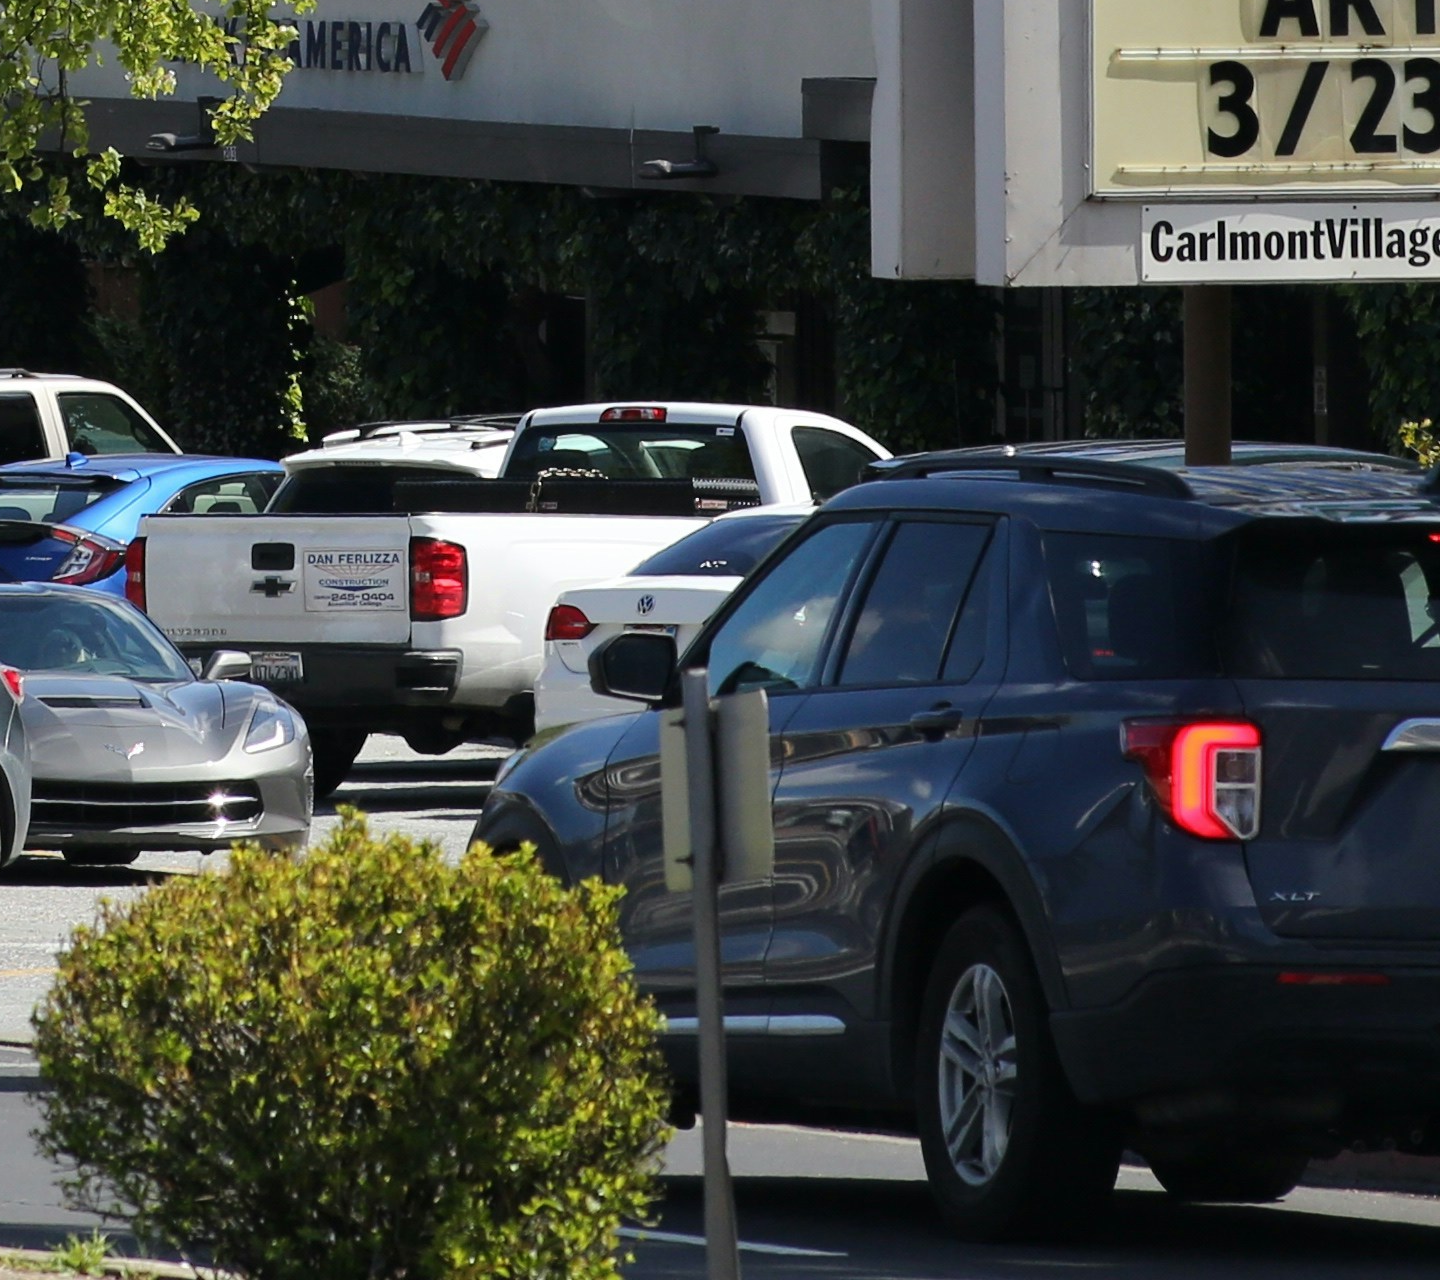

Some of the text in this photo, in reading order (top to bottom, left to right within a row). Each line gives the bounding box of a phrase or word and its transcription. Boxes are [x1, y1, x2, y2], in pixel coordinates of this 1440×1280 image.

[307, 553, 400, 564] DAN FERLIZZA
[319, 578, 389, 586] CONSTRUCTION
[1269, 891, 1321, 902] XLT
